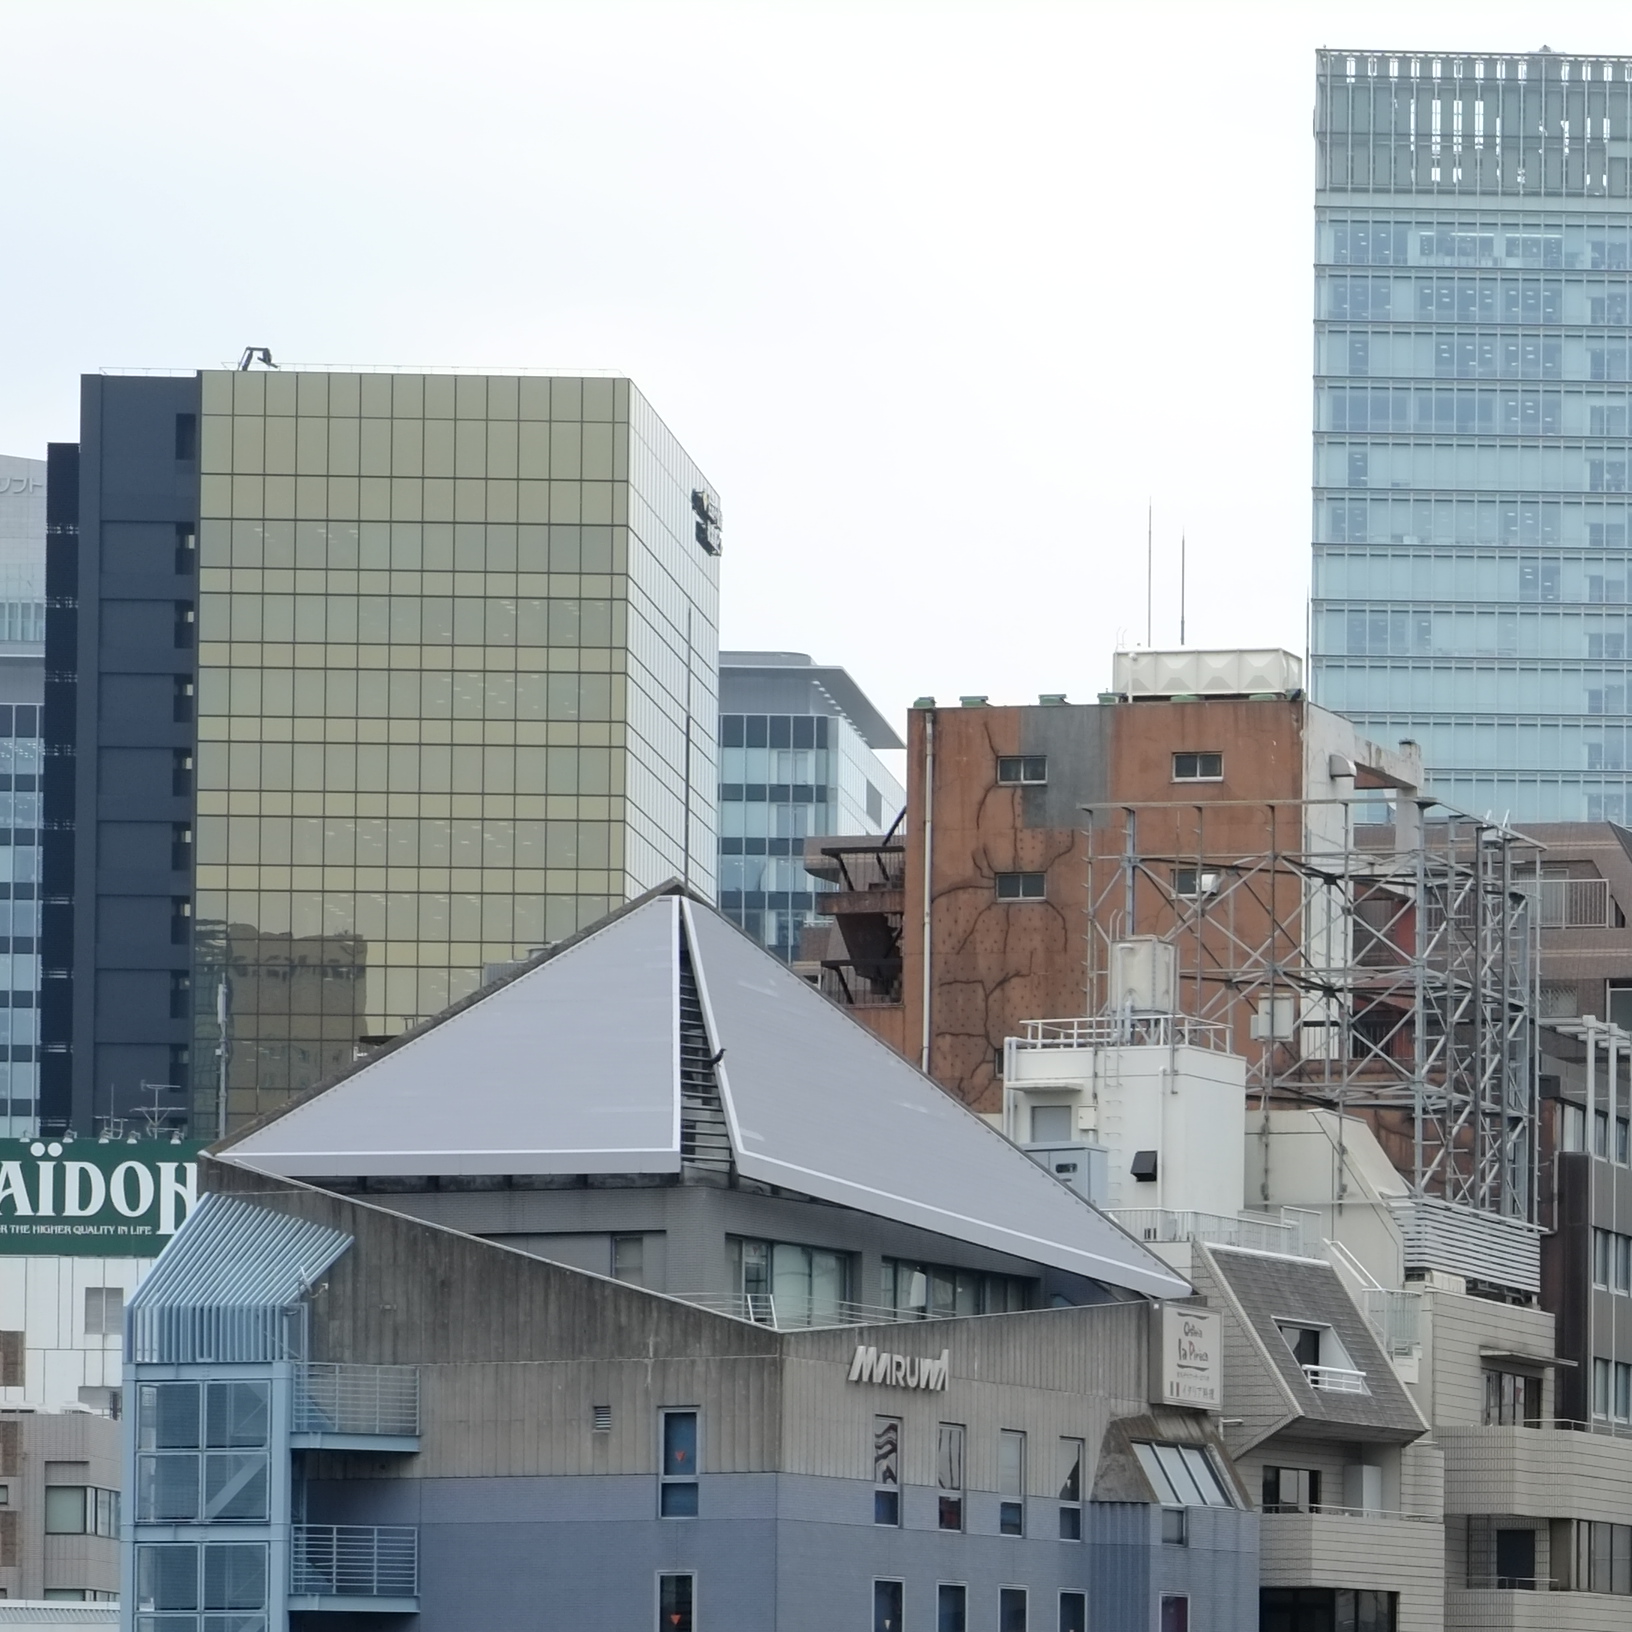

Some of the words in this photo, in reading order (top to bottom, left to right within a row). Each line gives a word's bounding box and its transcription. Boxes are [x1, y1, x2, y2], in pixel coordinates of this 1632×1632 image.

[9, 1225, 31, 1234] THE
[33, 1225, 71, 1234] HIGHER
[73, 1226, 115, 1236] QUALITY
[118, 1226, 128, 1235] IN
[130, 1226, 152, 1235] LIFE
[847, 1345, 949, 1391] MARUWA
